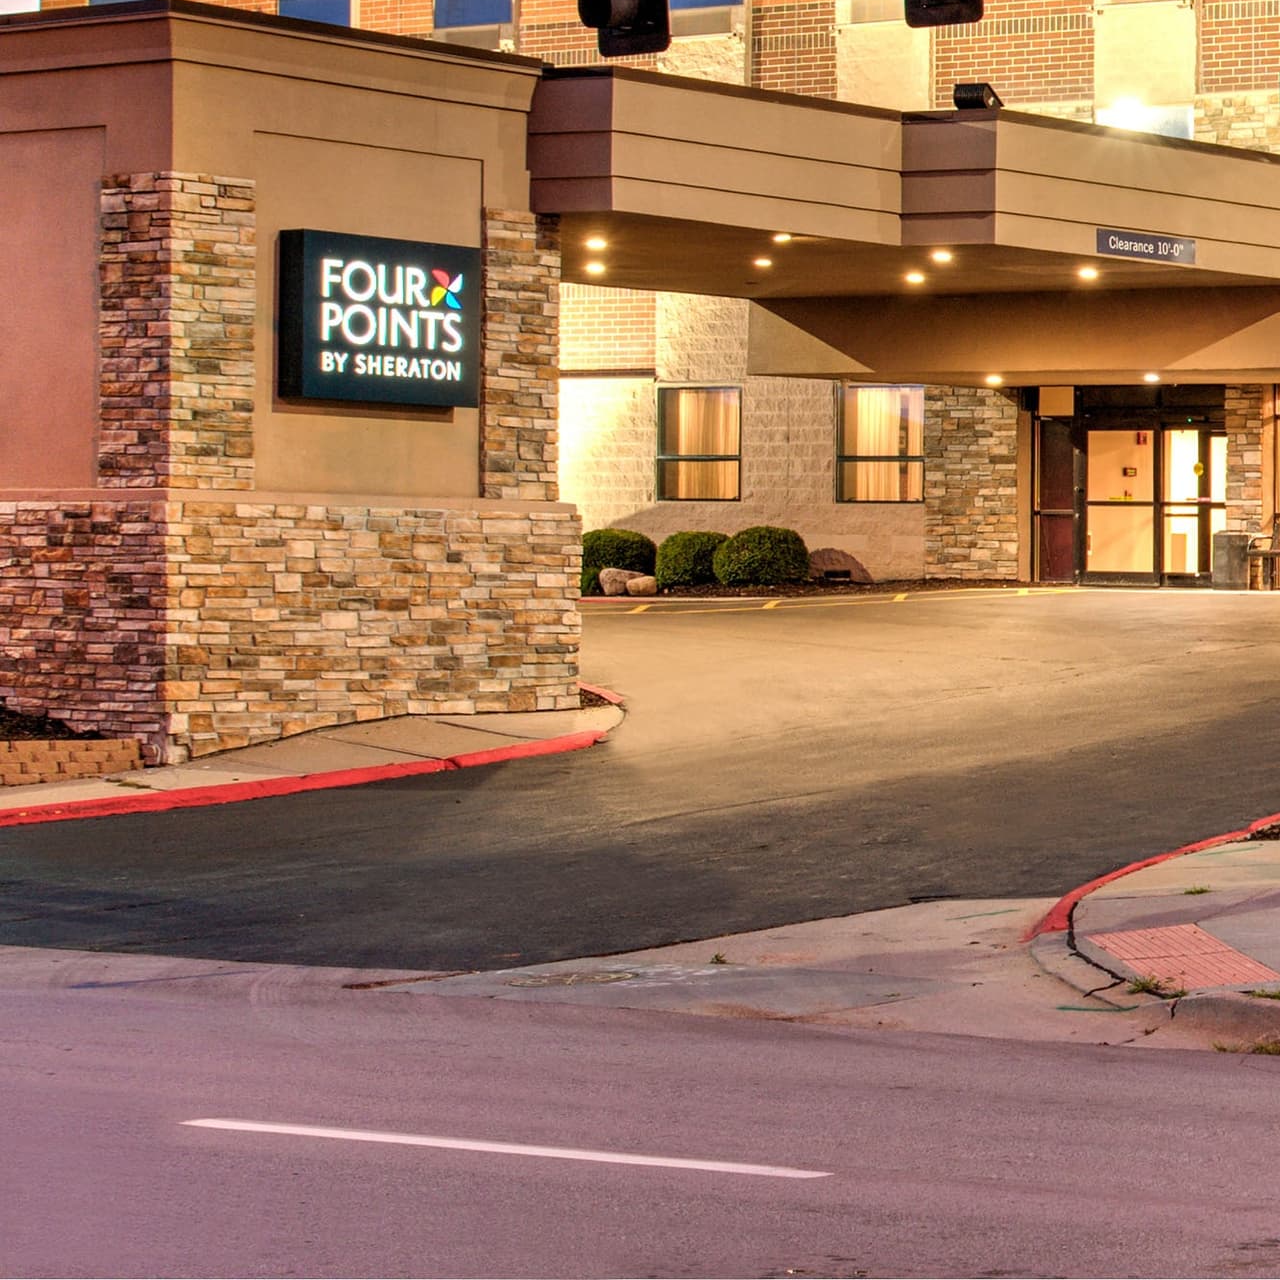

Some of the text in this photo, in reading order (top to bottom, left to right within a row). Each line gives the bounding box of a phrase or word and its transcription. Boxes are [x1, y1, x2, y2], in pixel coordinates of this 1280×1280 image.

[1108, 235, 1154, 254] Clearance
[321, 258, 430, 308] FOUR
[321, 302, 464, 353] POINTS
[320, 351, 462, 382] BY SHERATON
